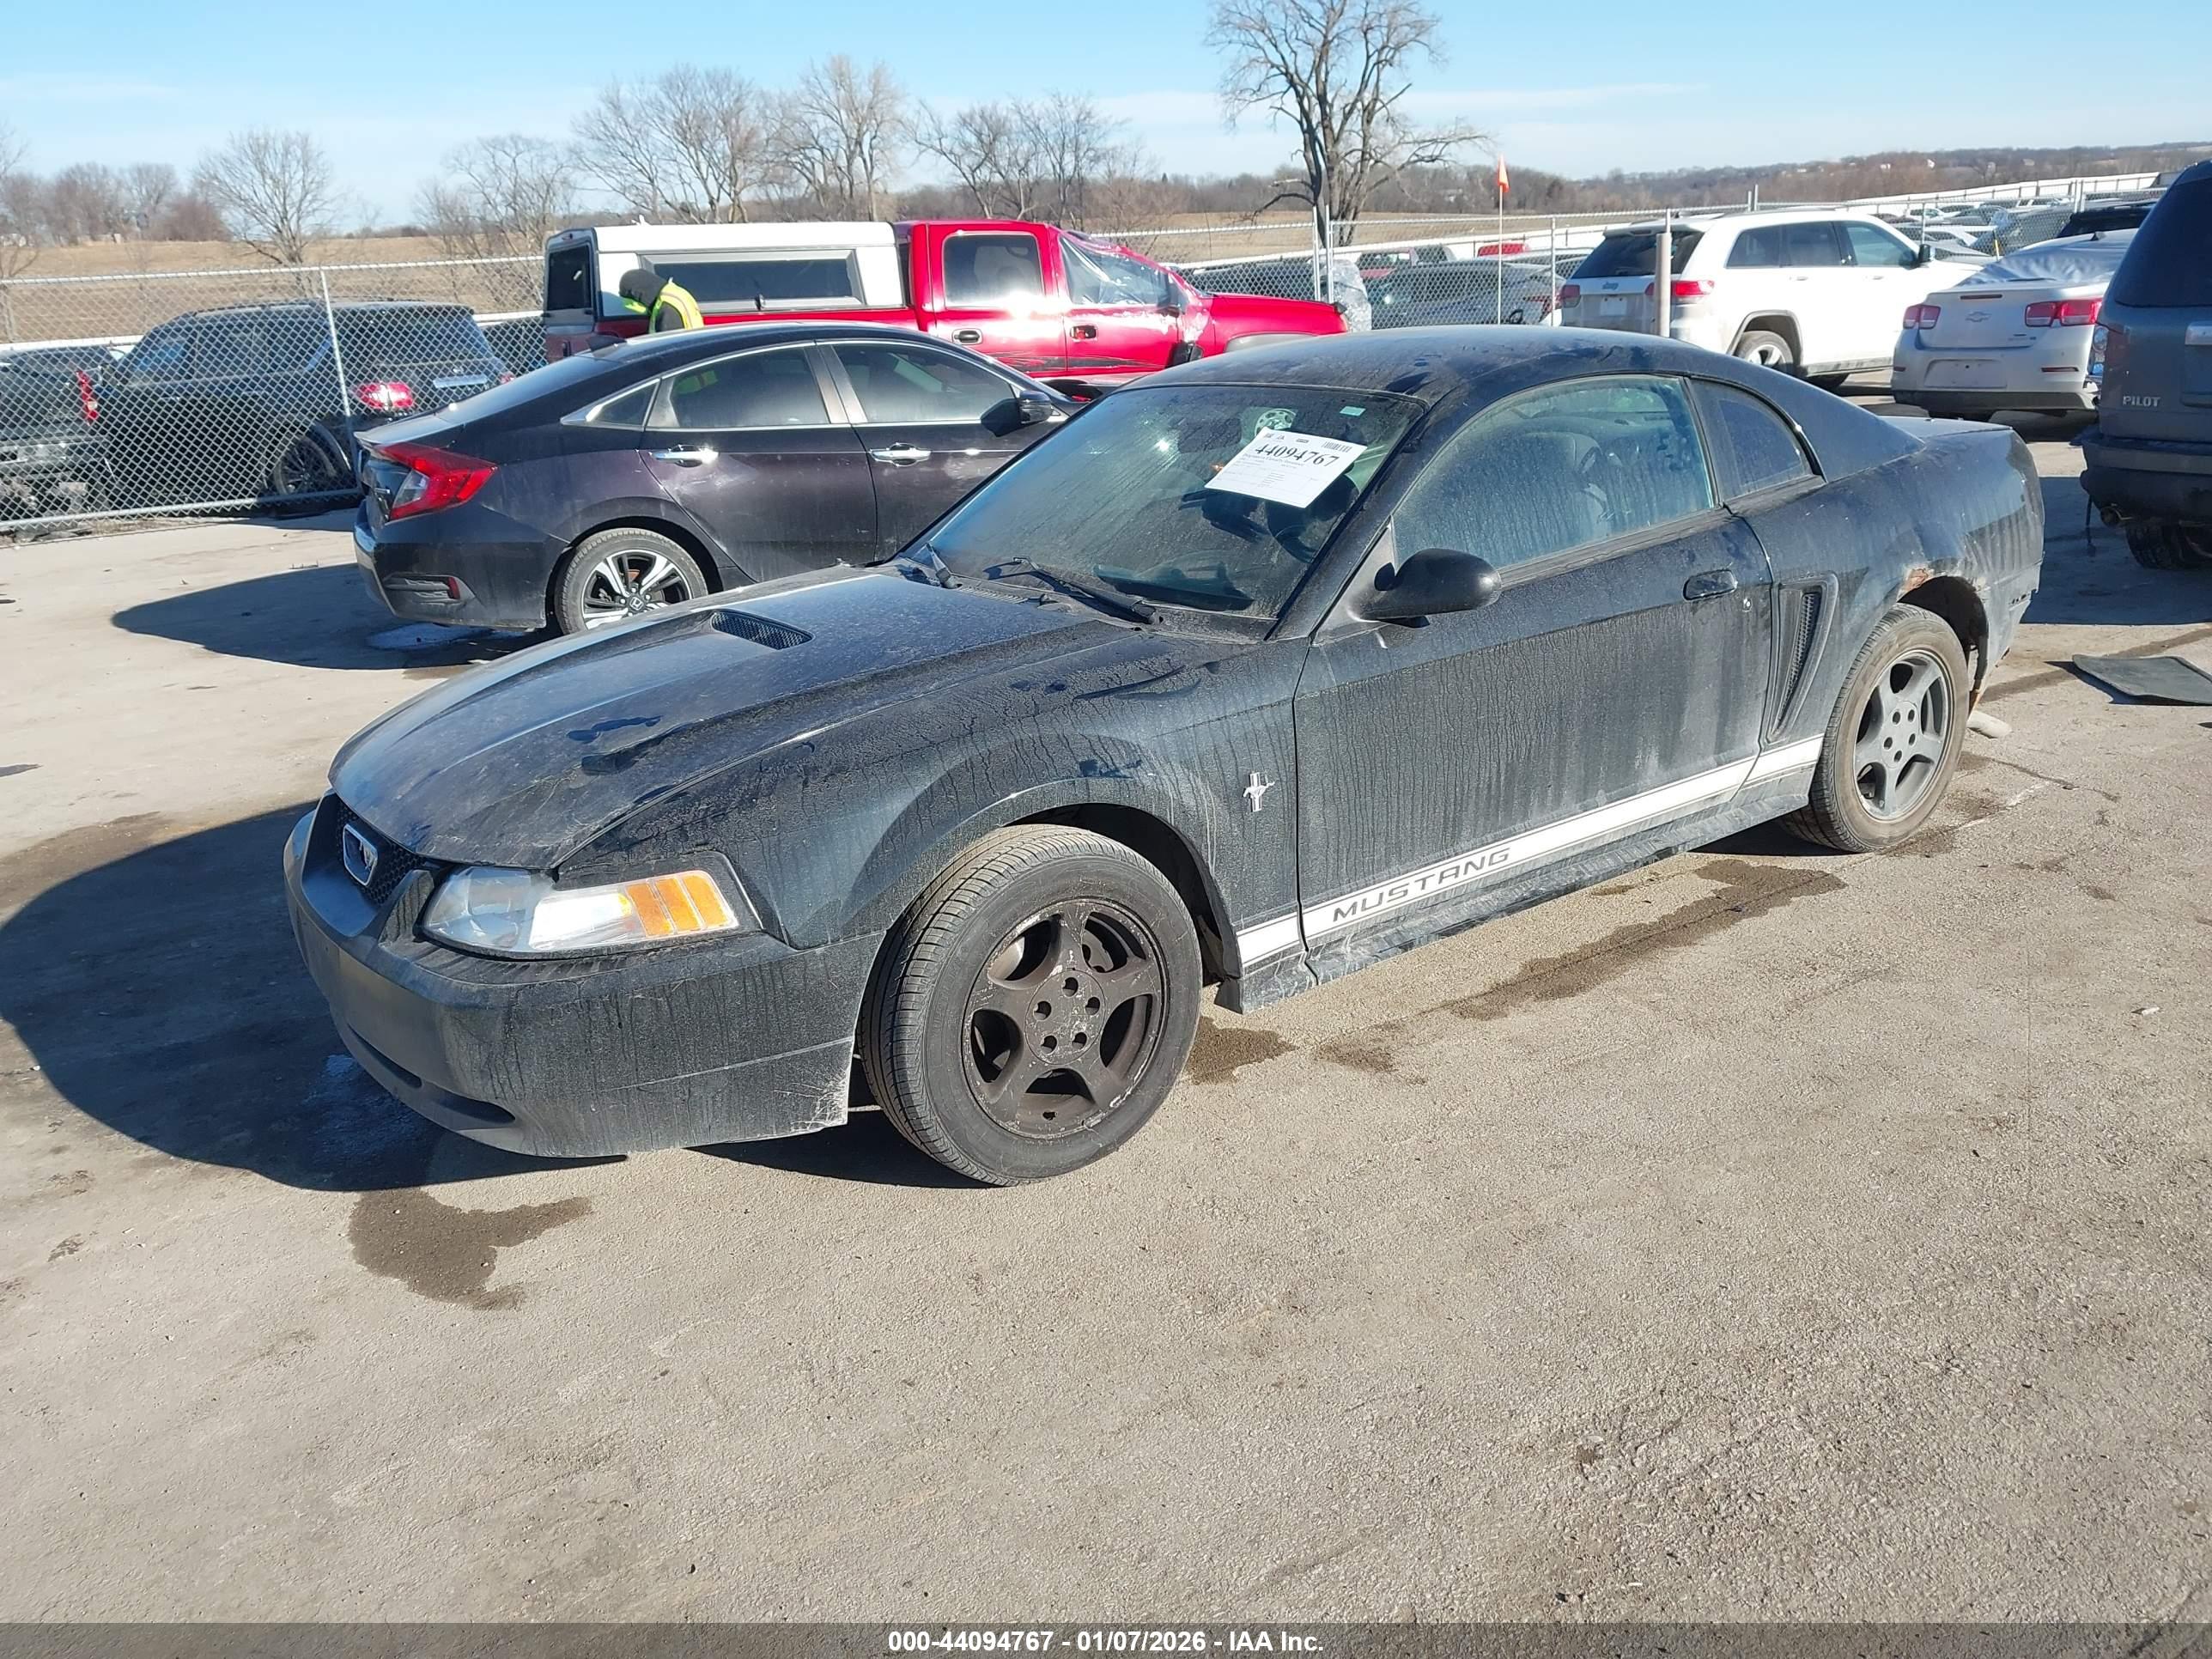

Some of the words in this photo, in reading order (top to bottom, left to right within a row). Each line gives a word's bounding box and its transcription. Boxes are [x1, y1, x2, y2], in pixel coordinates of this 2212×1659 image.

[2122, 395, 2161, 407] PILOT
[1255, 443, 1340, 467] 44094767
[1332, 847, 1510, 922] MUSTANG
